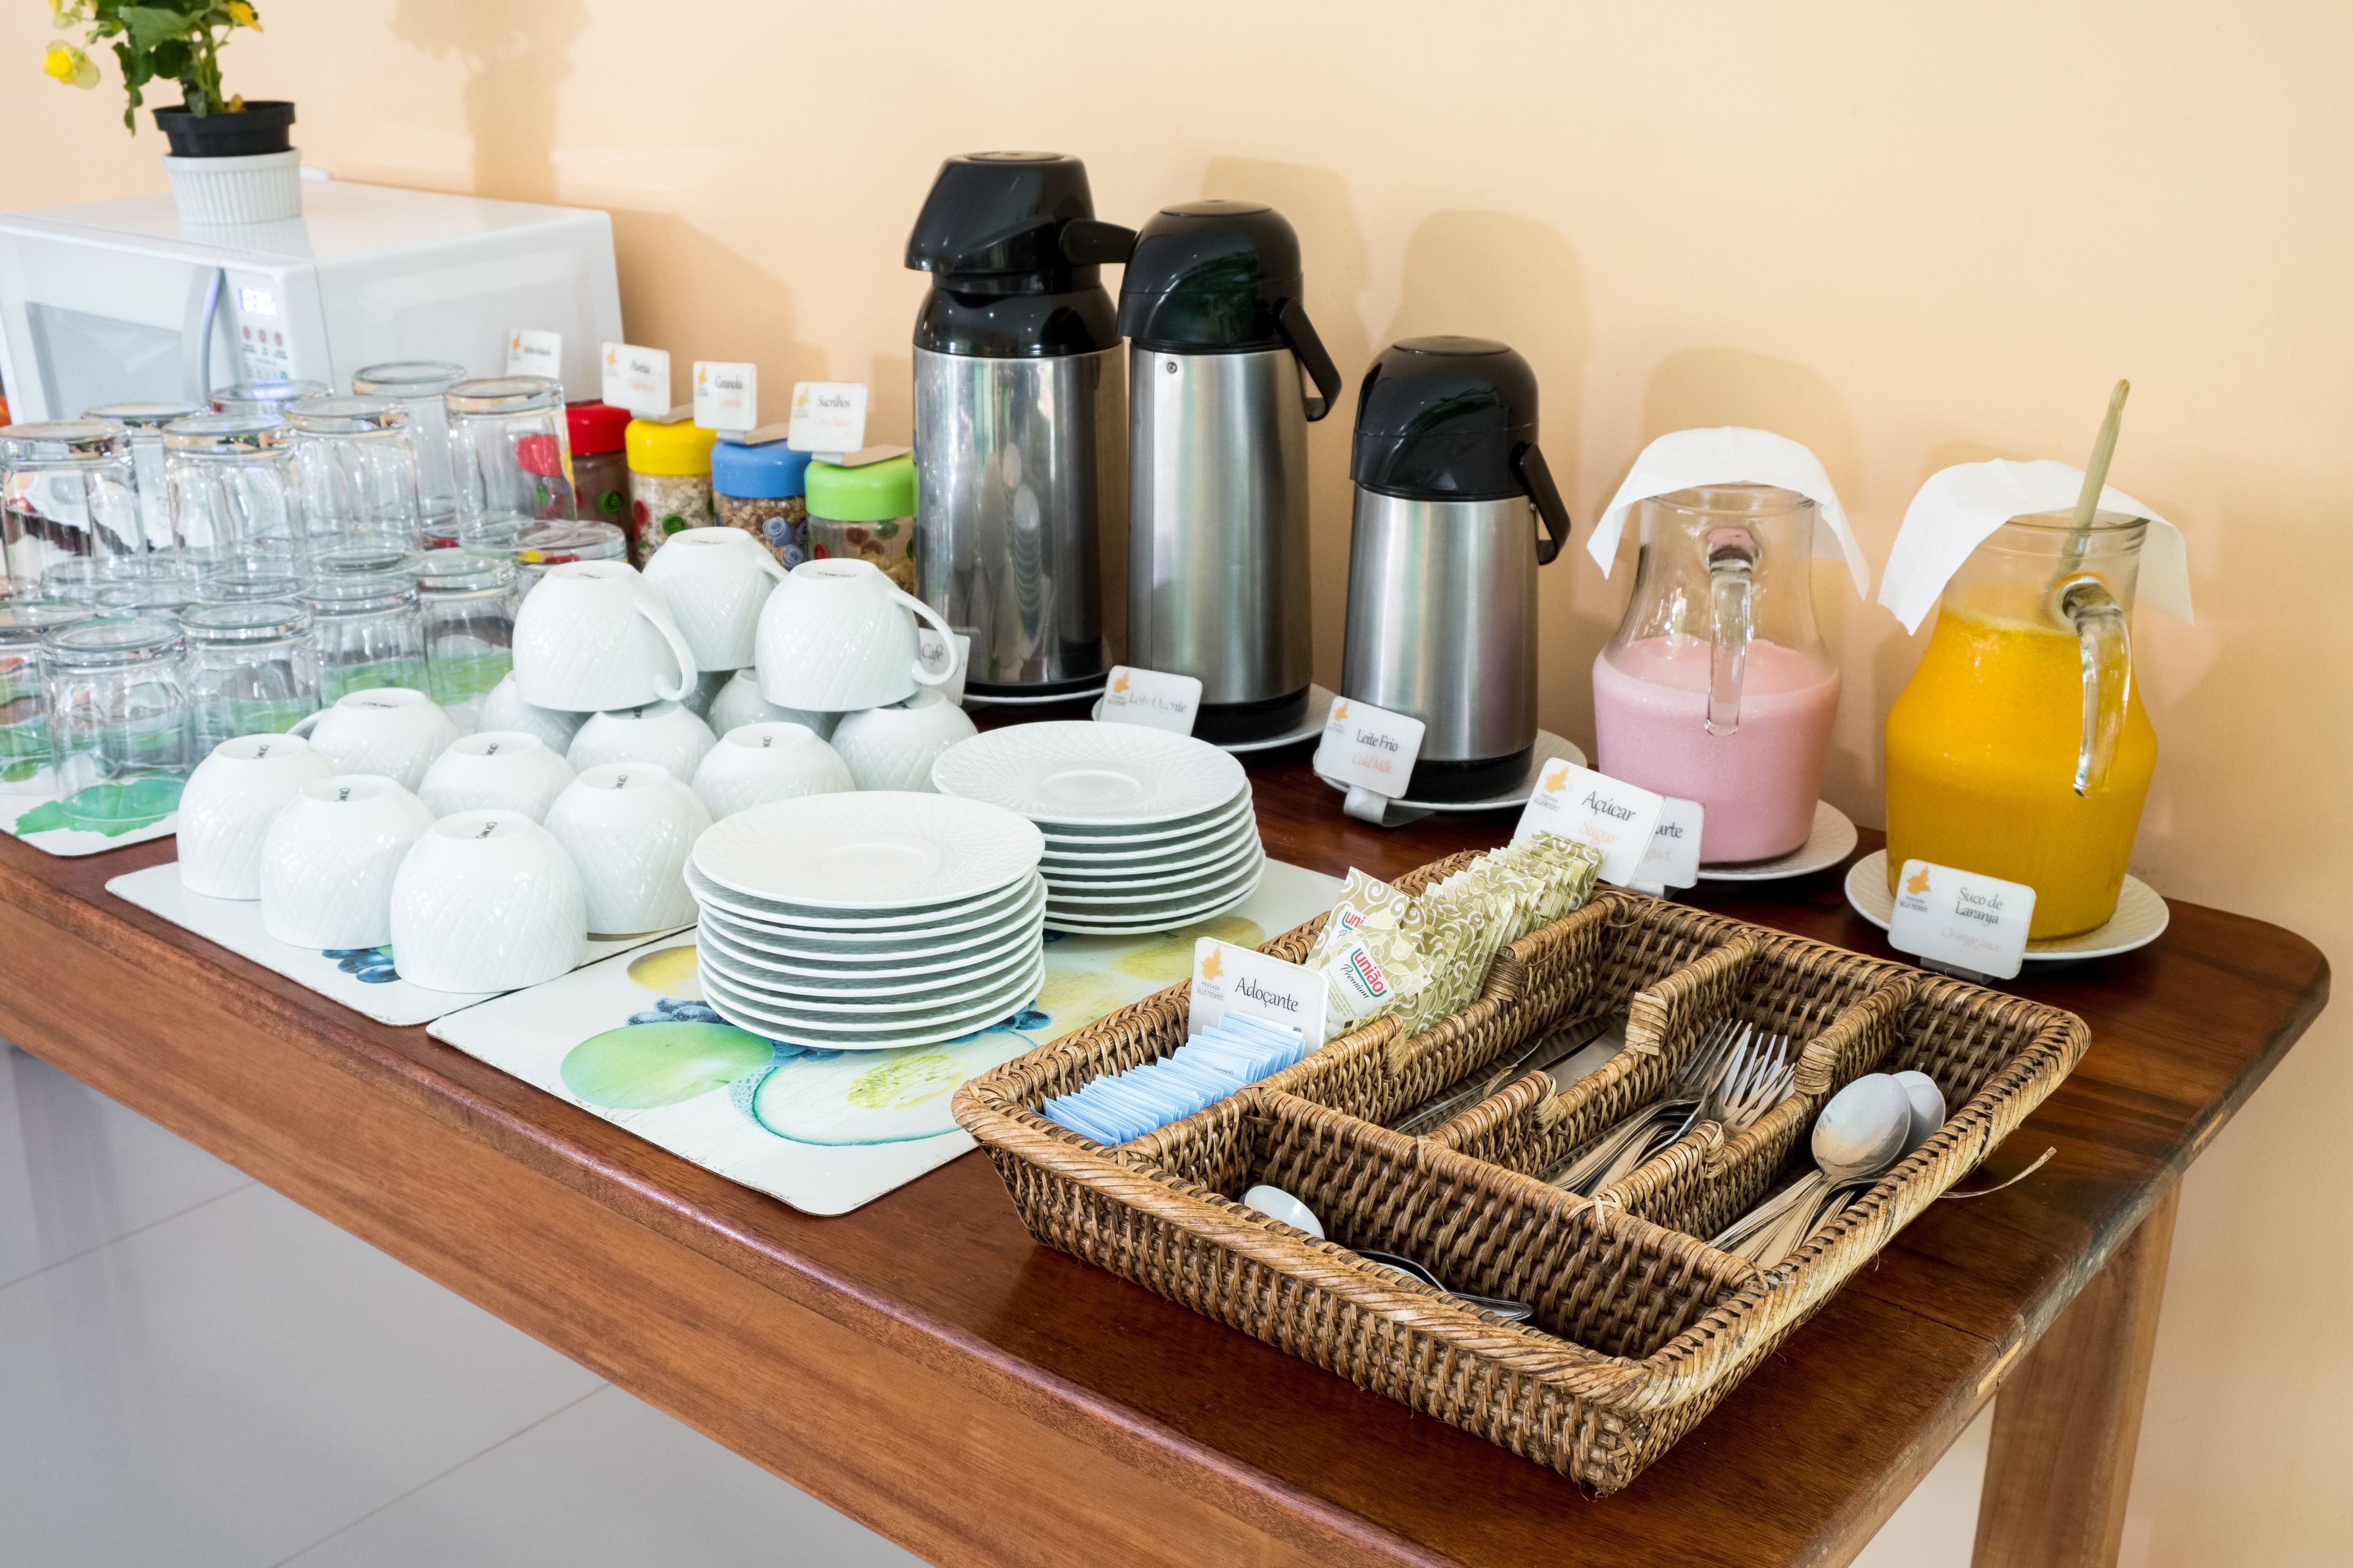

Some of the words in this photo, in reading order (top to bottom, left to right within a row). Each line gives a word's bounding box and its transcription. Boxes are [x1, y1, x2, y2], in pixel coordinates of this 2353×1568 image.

[922, 643, 944, 665] Café
[1356, 729, 1379, 747] Leite
[1379, 735, 1399, 752] Frio
[1582, 790, 1635, 822] Açúcar
[1579, 820, 1618, 845] Sugar
[1655, 822, 1683, 838] urte
[1958, 887, 1987, 906] Suco
[1987, 893, 2003, 911] de
[1345, 911, 1366, 928] uni
[1955, 901, 1999, 927] Laranja
[1340, 964, 1370, 999] Premium
[1354, 951, 1384, 993] união
[1201, 980, 1220, 991] POUSADA
[1235, 975, 1299, 1012] Adoçante
